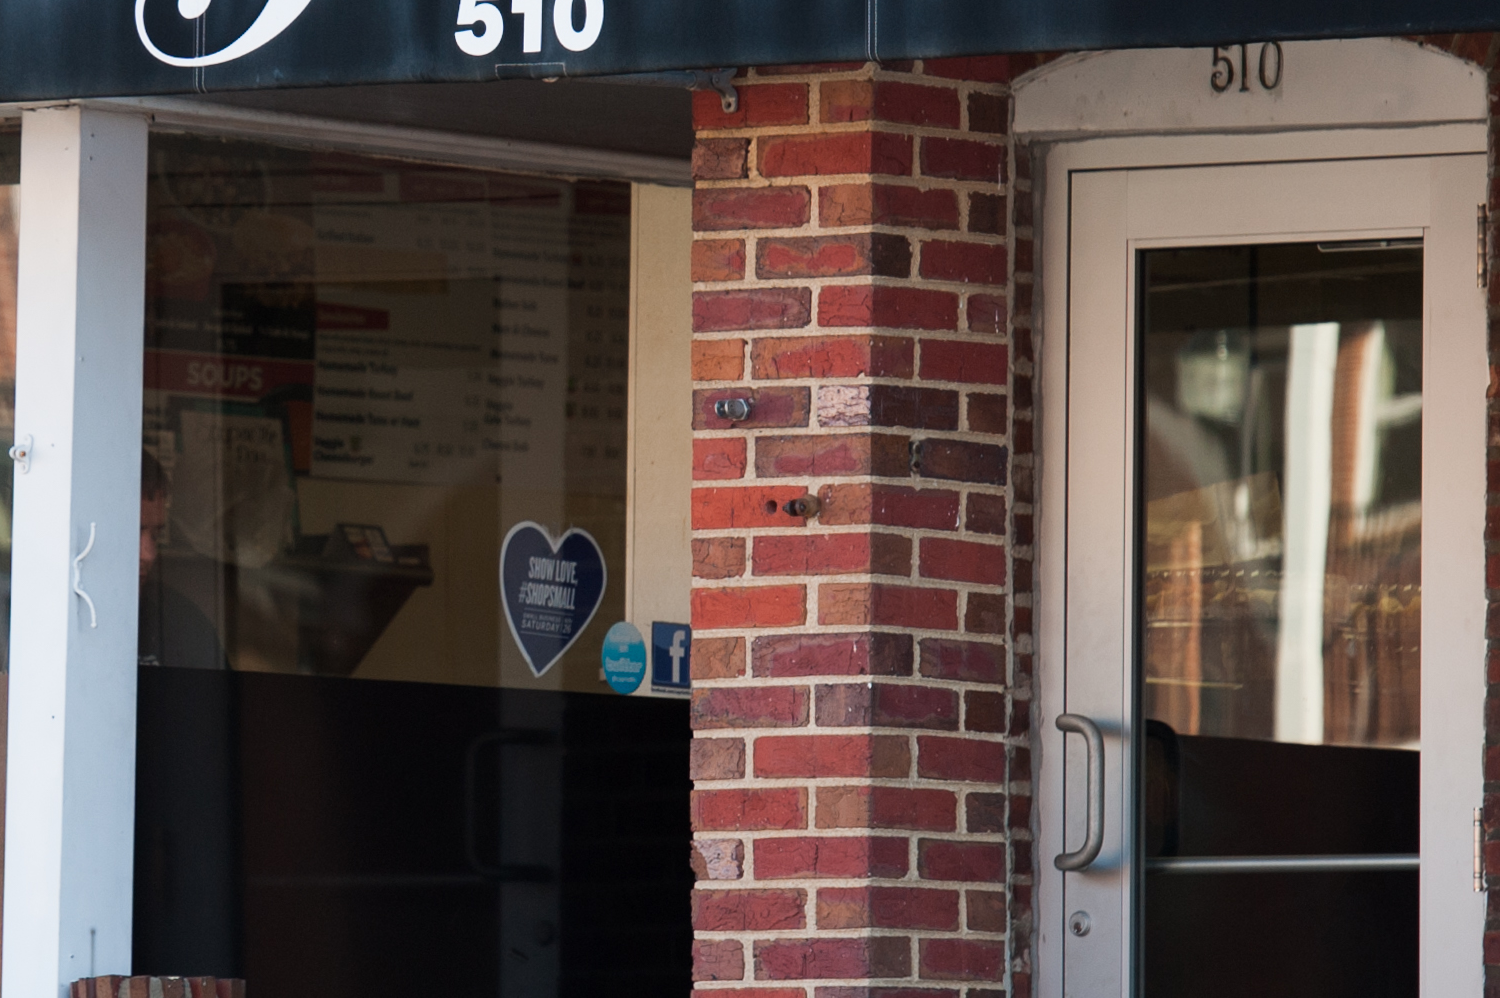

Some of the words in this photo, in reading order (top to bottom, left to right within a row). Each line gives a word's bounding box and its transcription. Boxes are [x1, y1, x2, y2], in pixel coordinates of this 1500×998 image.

[1210, 42, 1284, 93] 510
[186, 361, 264, 392] SOUPS
[528, 556, 555, 581] SHOW
[518, 581, 576, 610] #SHOPSMALL
[521, 619, 560, 633] SATURDAY
